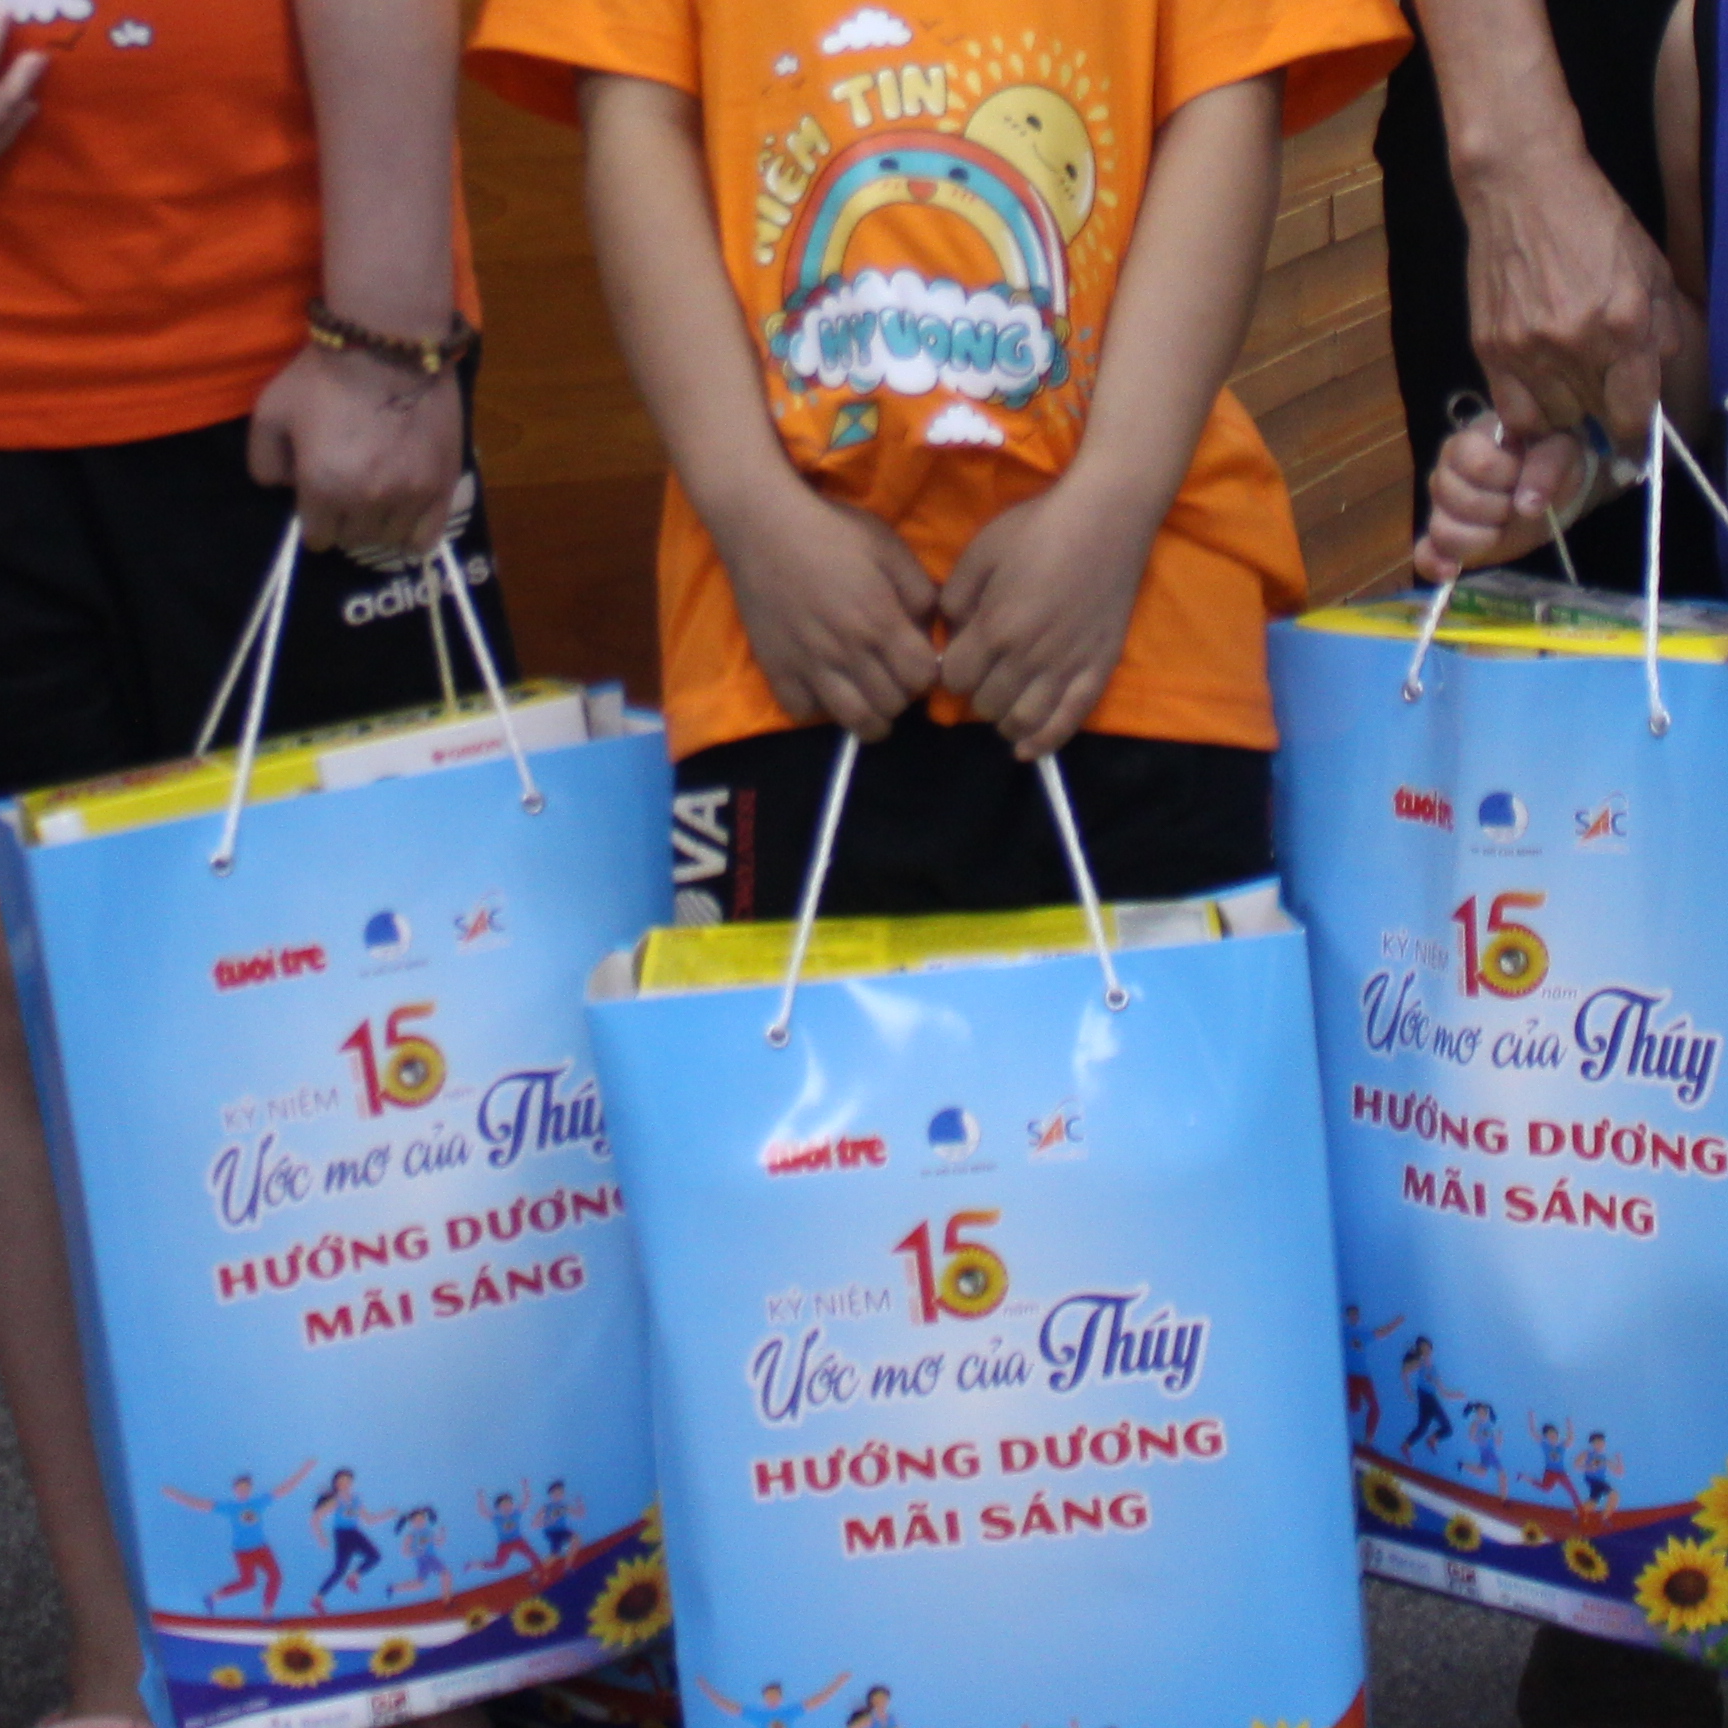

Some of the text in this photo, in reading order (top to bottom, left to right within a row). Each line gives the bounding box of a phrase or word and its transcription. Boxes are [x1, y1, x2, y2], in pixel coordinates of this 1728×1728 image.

[830, 64, 948, 128] TIN
[1452, 891, 1550, 999] 15
[340, 1002, 446, 1116] 15
[1492, 1019, 1567, 1070] của
[1575, 987, 1718, 1104] Thúy
[403, 1121, 471, 1179] của
[1353, 1084, 1728, 1176] HƯỚNG DƯƠNG
[1403, 1165, 1656, 1237] MÃI SÁNG
[217, 1226, 430, 1300] HƯỚNG
[303, 1254, 584, 1345] MÃI SÁNG
[891, 1209, 1009, 1325] 15
[958, 1336, 1035, 1391] của
[1039, 1292, 1206, 1393] Thúy
[754, 1420, 1224, 1498] HƯỚNG DƯƠNG
[844, 1490, 1149, 1554] MÃI SÁNG
